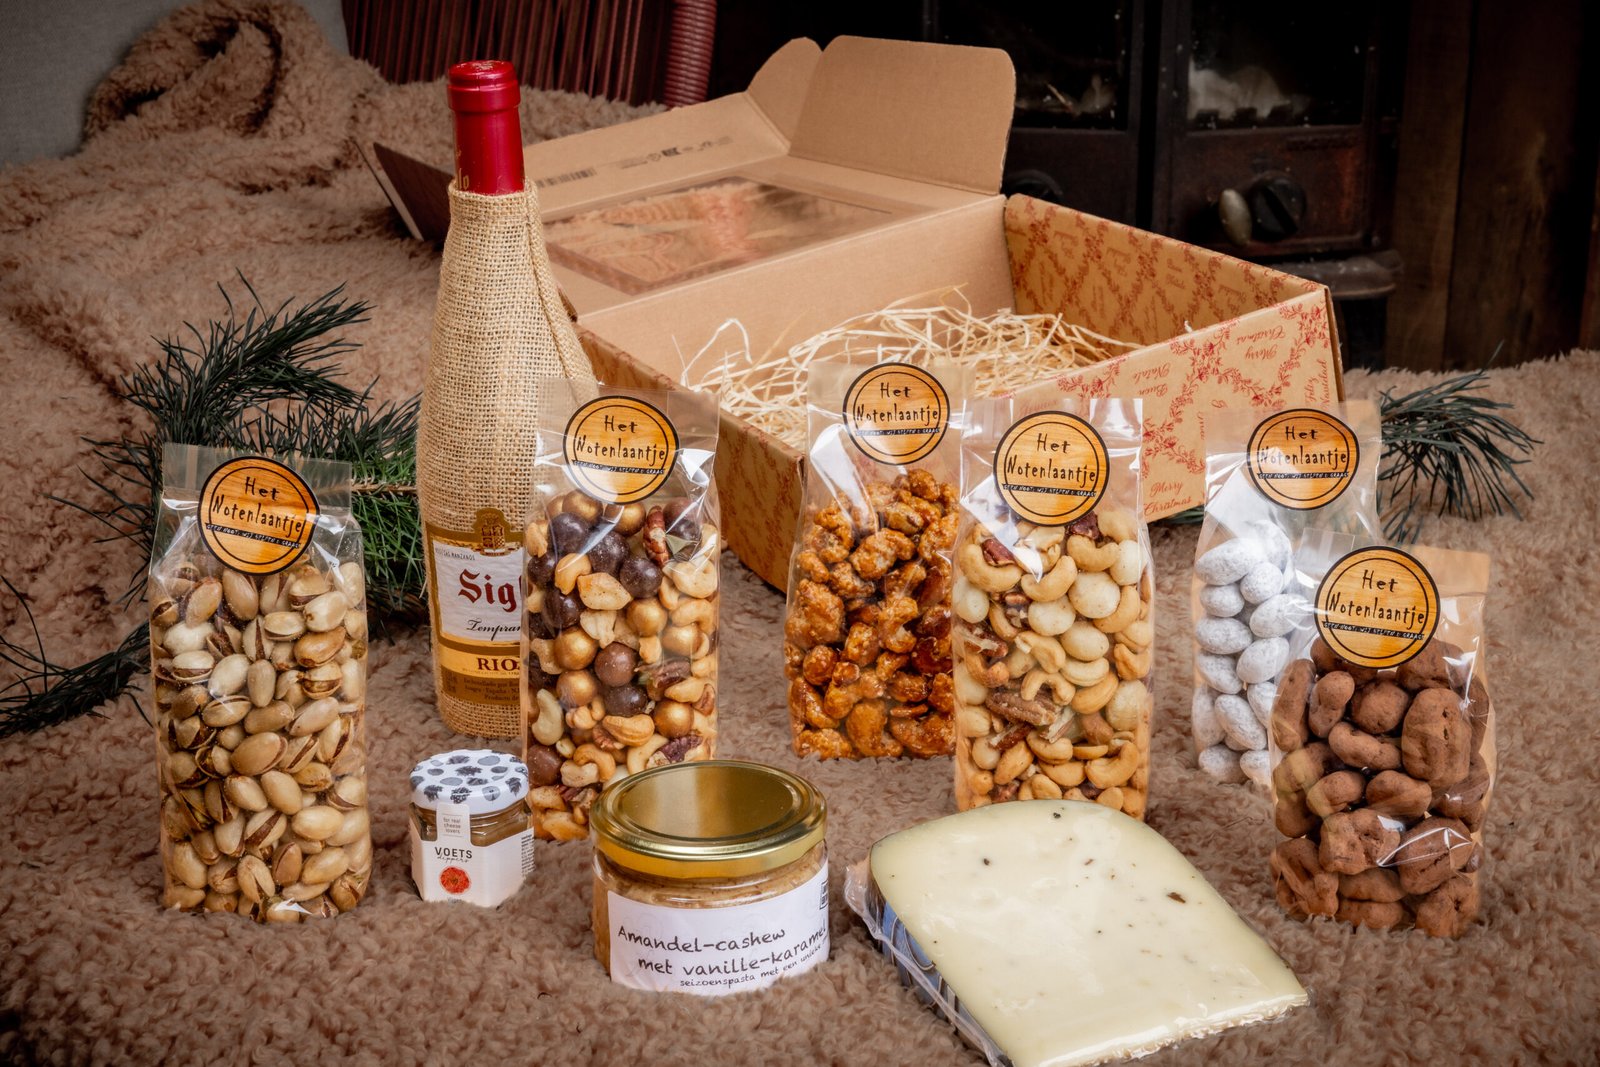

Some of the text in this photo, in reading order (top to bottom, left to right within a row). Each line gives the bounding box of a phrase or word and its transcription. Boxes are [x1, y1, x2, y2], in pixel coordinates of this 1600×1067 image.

[1236, 325, 1287, 344] Christmas
[1245, 345, 1278, 360] Merry
[1133, 363, 1171, 384] Natale
[880, 382, 911, 398] Het
[1139, 384, 1168, 396] Buon
[604, 414, 638, 433] Het
[856, 403, 938, 426] Notenlaantje
[1037, 433, 1071, 454] Het
[1285, 426, 1318, 440] Het
[576, 434, 666, 467] Notenlaantje
[1260, 445, 1347, 470] Notenlaantje
[1007, 454, 1096, 488] Notenlaantje
[244, 476, 280, 501] Het
[1150, 482, 1184, 498] Merry
[212, 494, 302, 538] Notenlaantje
[1362, 569, 1398, 593] Het
[1328, 592, 1425, 630] Notenlaantje
[435, 846, 473, 859] VOETS
[617, 925, 786, 953] Amandel-cashew
[638, 958, 672, 975] met
[680, 974, 756, 989] seizoenspasta
[760, 968, 780, 979] met
[783, 961, 798, 972] een
